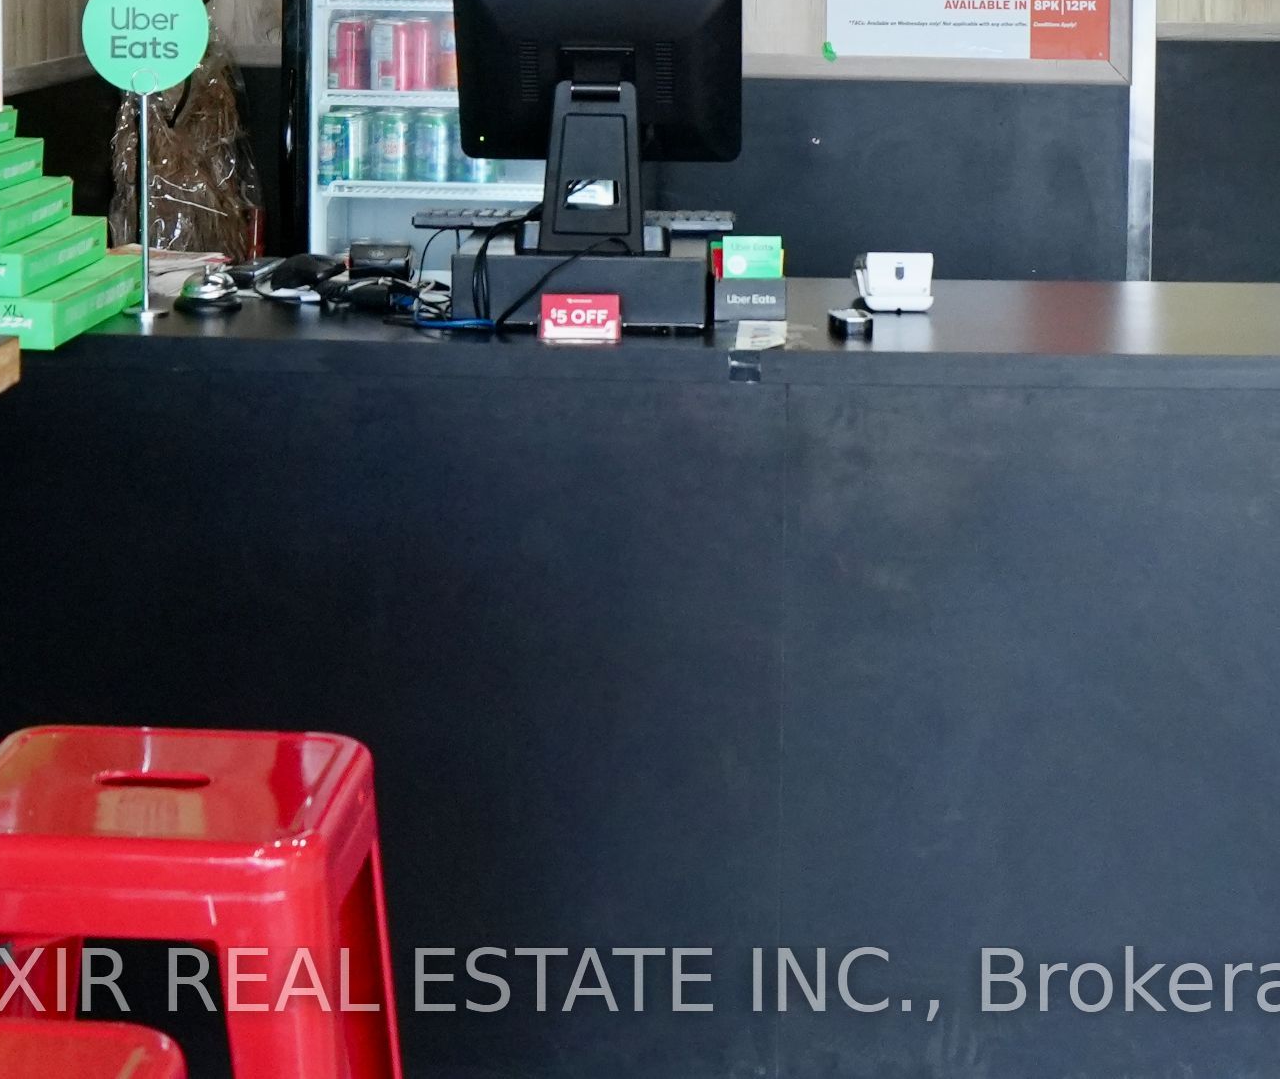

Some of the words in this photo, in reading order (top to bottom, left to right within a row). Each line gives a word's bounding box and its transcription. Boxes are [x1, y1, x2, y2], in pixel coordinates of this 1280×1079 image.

[944, 0, 1010, 10] AVAILABLE
[1015, 0, 1027, 10] IN
[1034, 0, 1059, 11] 8PK
[1066, 1, 1096, 11] 12PK
[111, 7, 179, 30] Uber
[110, 35, 179, 59] Eats
[727, 294, 751, 304] Uber
[752, 294, 776, 304] Eats
[551, 307, 567, 324] $5
[571, 309, 608, 324] OFF
